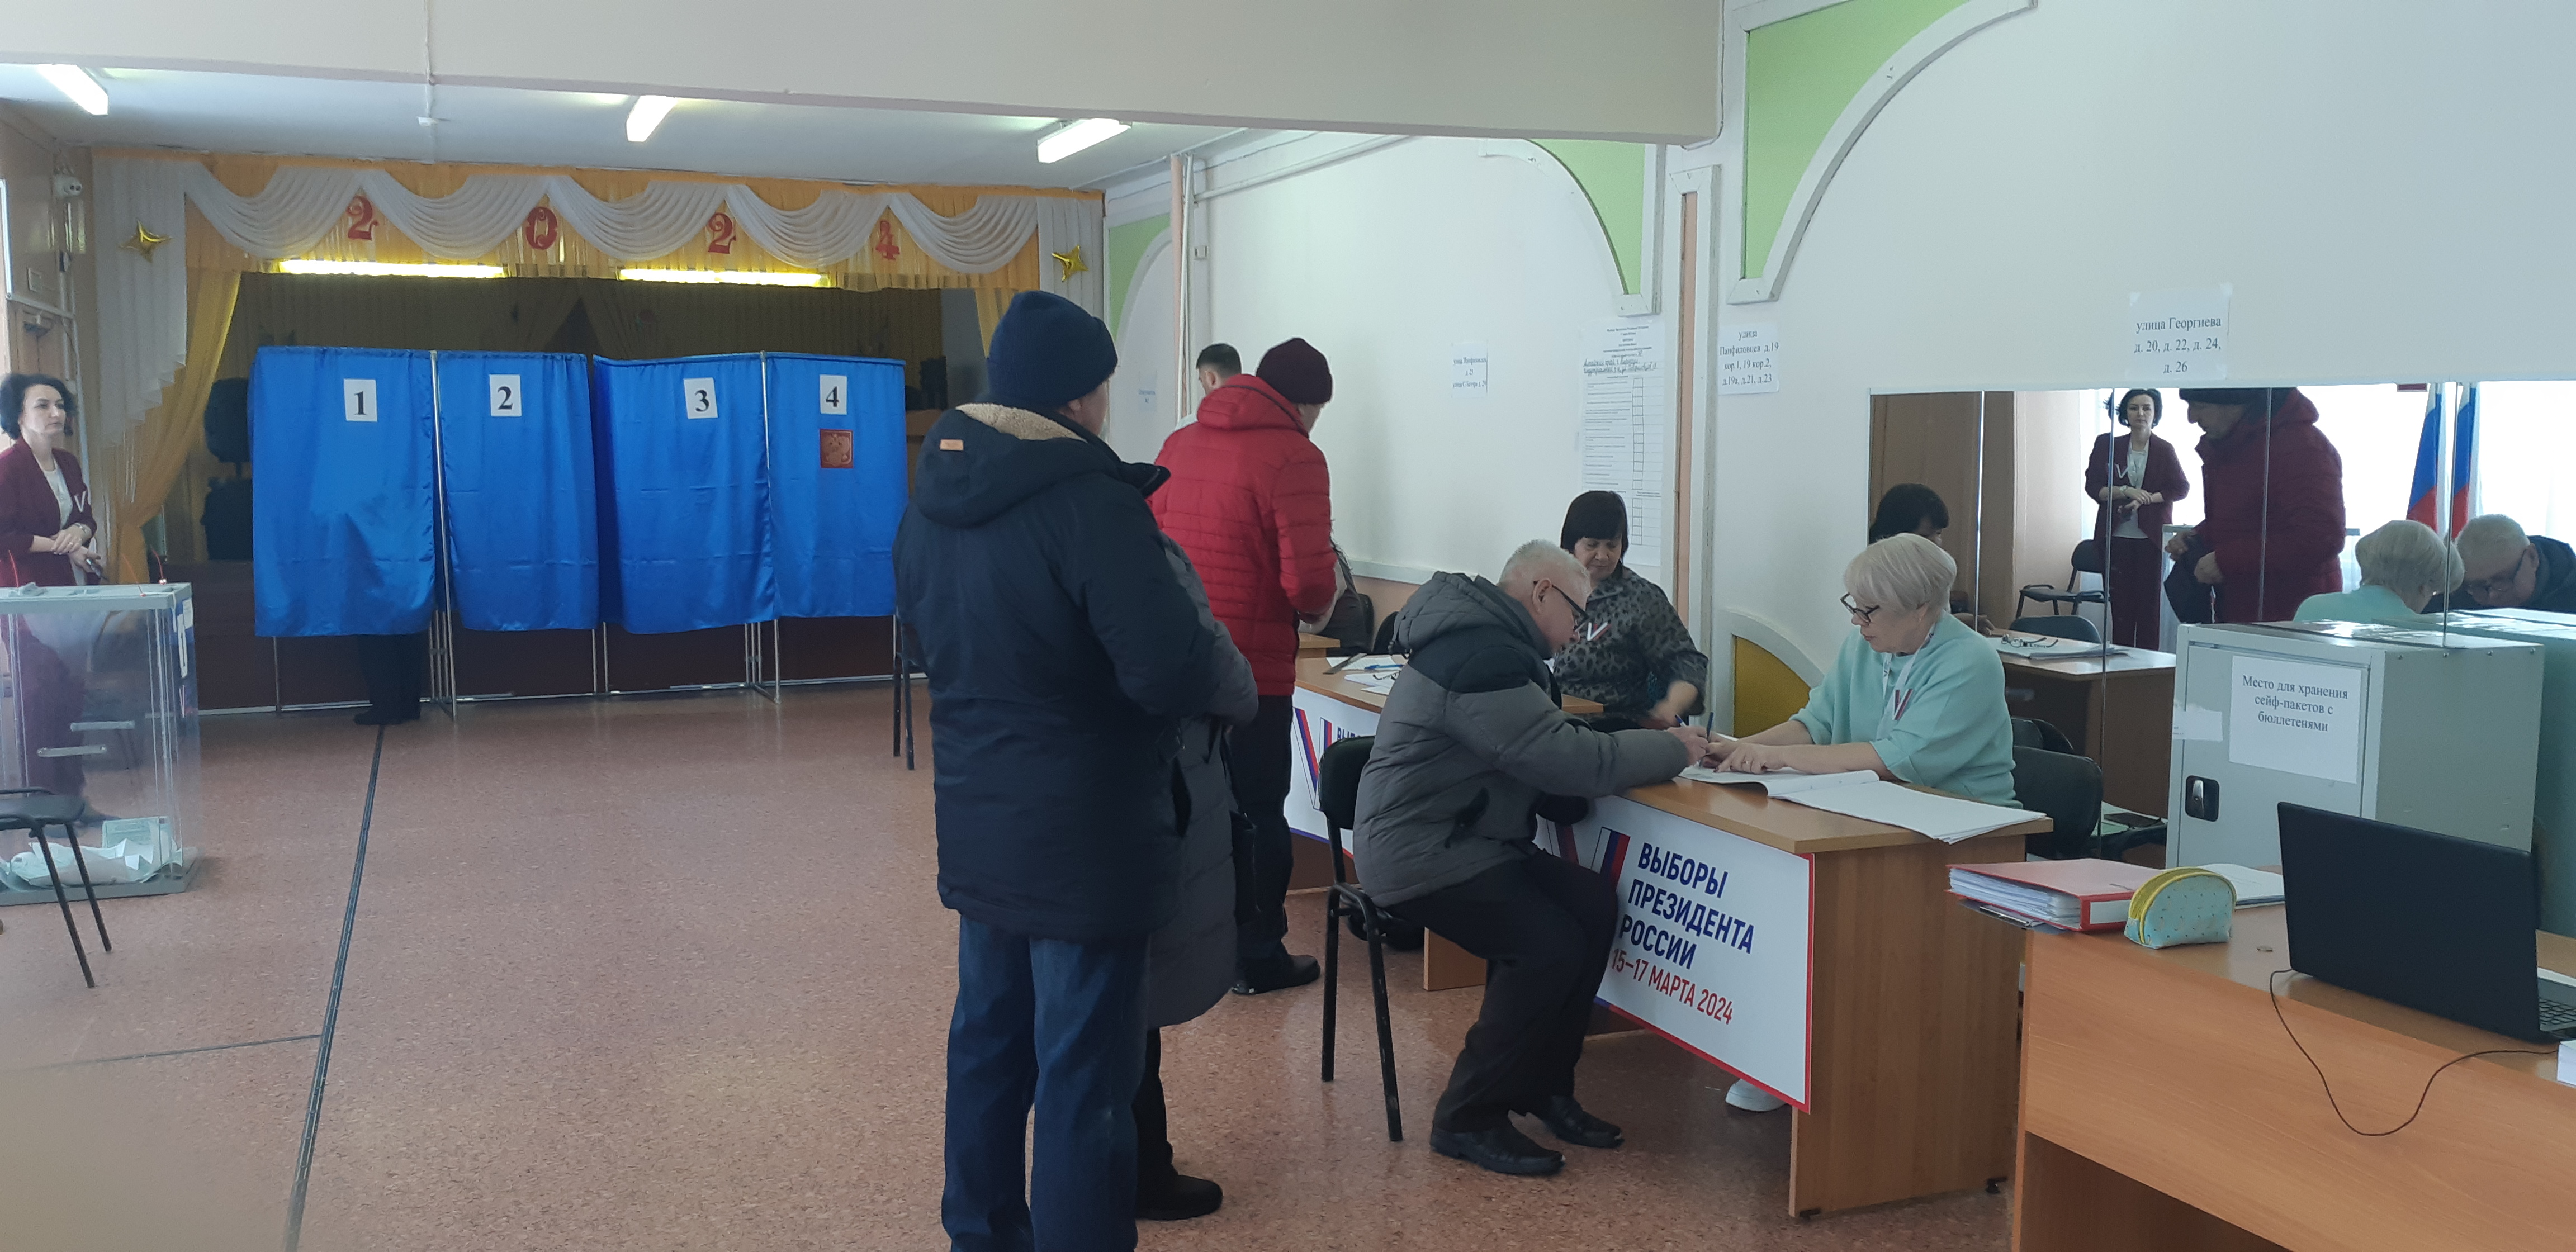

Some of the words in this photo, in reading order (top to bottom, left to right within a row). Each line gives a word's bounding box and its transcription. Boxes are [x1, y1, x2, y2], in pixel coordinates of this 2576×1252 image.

[346, 195, 379, 241] 2
[707, 212, 737, 254] 2
[1738, 330, 1758, 342] улица
[2135, 321, 2166, 334] улица
[2169, 317, 2222, 331] Георгиева
[2146, 340, 2161, 353] 20,
[2175, 339, 2190, 352] 22,
[2205, 337, 2222, 351] 24,
[2175, 361, 2187, 373] 26
[353, 391, 367, 416] 1
[497, 385, 513, 410] 2
[695, 390, 709, 412] 3
[825, 386, 840, 407] 4
[2242, 675, 2274, 690] Место
[2276, 682, 2295, 693] для
[2298, 684, 2348, 699] хранения
[2255, 695, 2324, 714] сейф-пакетов
[2327, 706, 2333, 715] с
[2258, 710, 2328, 732] бюллетенями
[1637, 842, 1729, 899] ВЫБОРЫ
[1627, 878, 1754, 955] ПРЕЗИДЕНТА
[1619, 913, 1697, 970] РОССИИ
[1648, 965, 1696, 1007] МАРТА
[1696, 988, 1734, 1025] 2024
